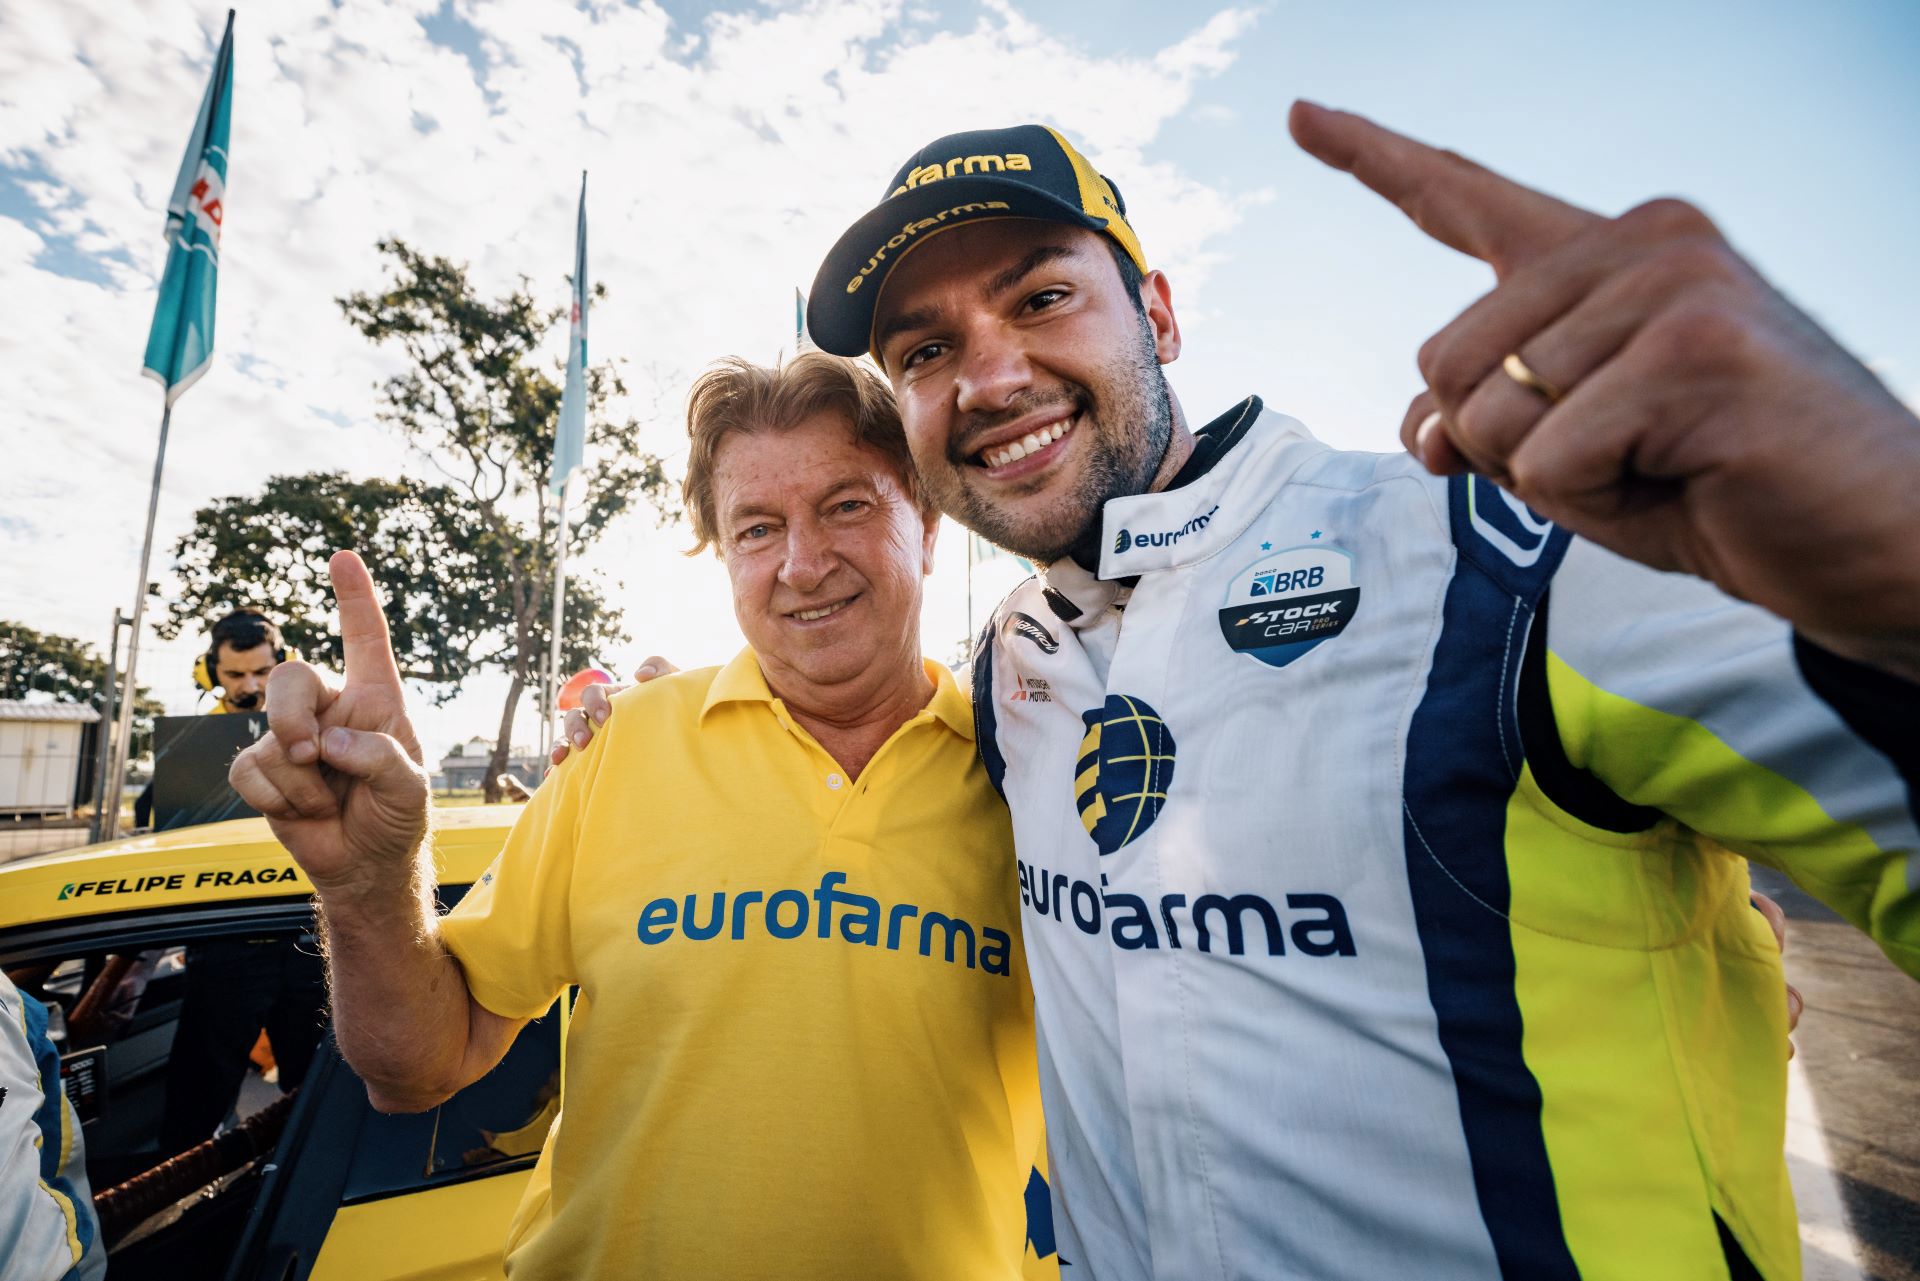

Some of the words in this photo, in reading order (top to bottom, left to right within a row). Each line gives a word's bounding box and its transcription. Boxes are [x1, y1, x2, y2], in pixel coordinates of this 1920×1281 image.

[890, 153, 1032, 199] farma
[846, 200, 1010, 294] eurofarma
[1275, 566, 1324, 593] BRB
[1249, 600, 1342, 624] STOCK
[1311, 621, 1339, 631] SERIES
[74, 874, 185, 897] FELIPE
[195, 867, 298, 889] FRAGA
[636, 872, 1011, 977] eurofarma
[1018, 859, 1357, 957] euroarma
